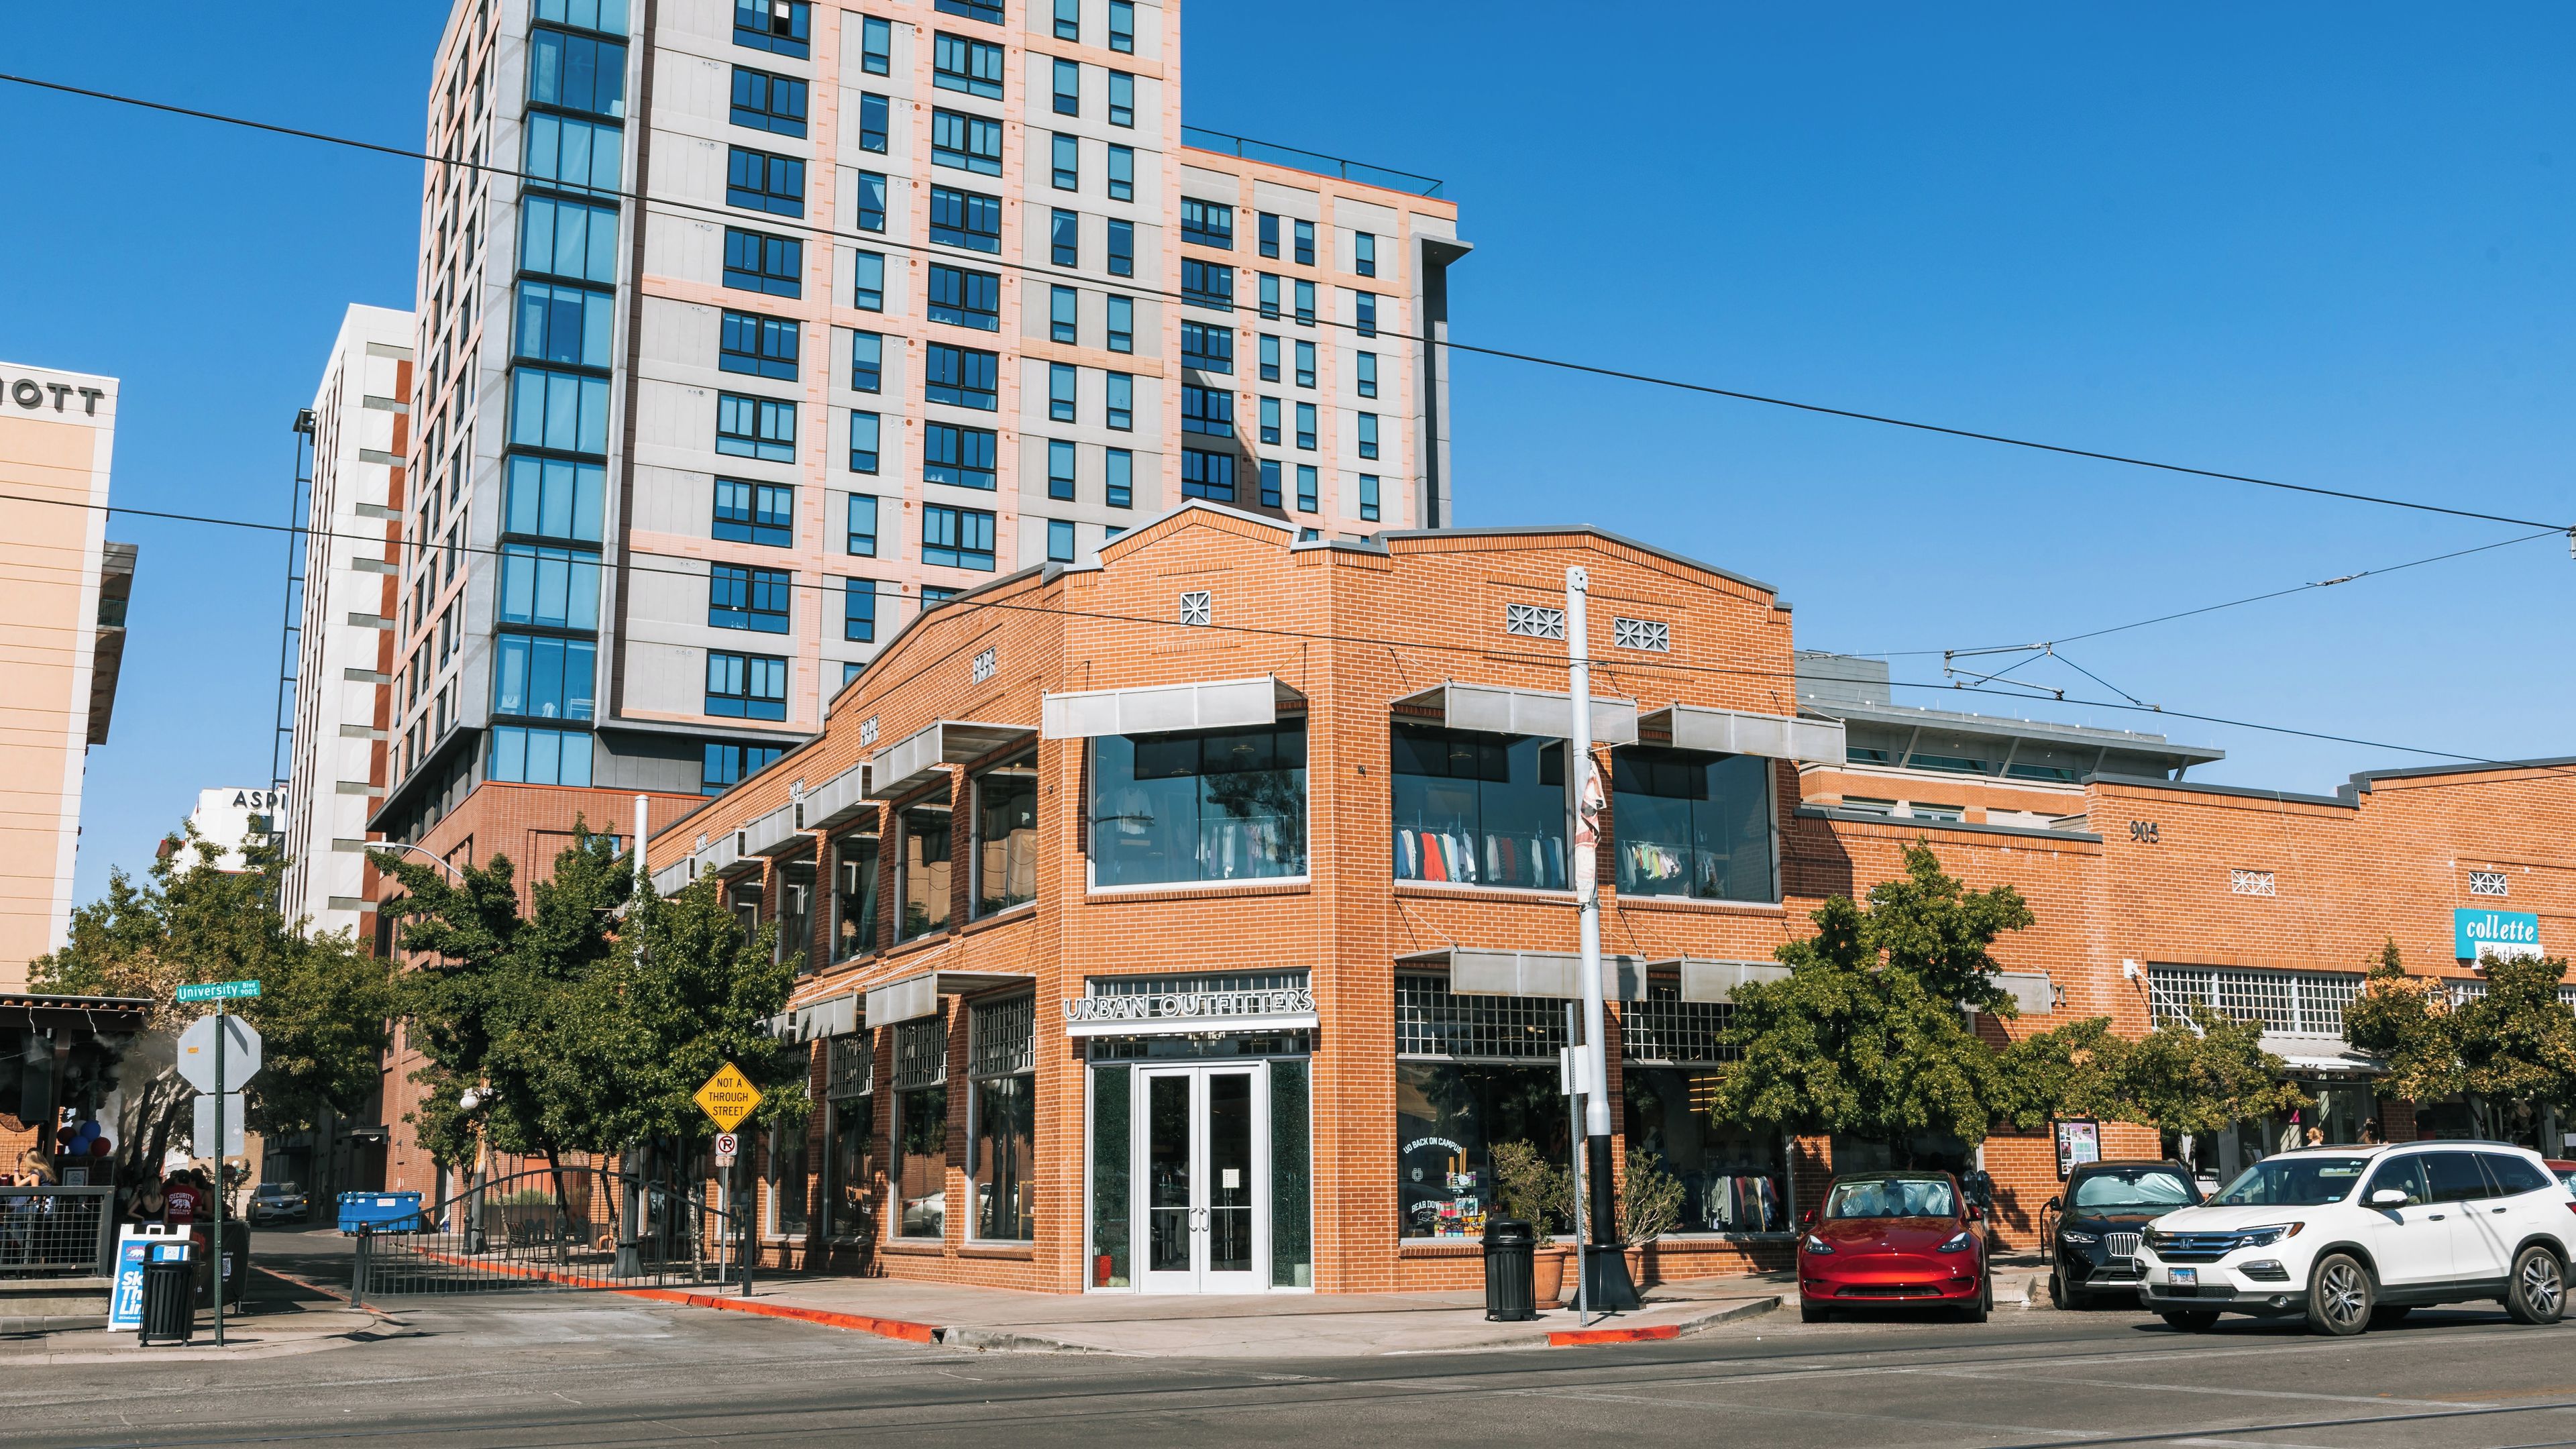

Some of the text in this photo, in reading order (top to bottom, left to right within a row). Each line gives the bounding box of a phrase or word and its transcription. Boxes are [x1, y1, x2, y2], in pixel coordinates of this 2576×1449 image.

[233, 790, 286, 810] ASPI
[2131, 820, 2159, 843] 905
[2467, 914, 2534, 941] collette
[179, 985, 237, 1000] University
[1063, 989, 1316, 1020] URBAN OUTFITTERS
[717, 1078, 743, 1088] NOT A
[708, 1092, 748, 1102] THROUGH
[712, 1106, 744, 1116] STREET
[1403, 1136, 1463, 1154] UO BACK ON CAMPUS
[169, 1192, 195, 1203] SECURITY
[1411, 1200, 1444, 1214] BEAR DOWN
[121, 1271, 143, 1286] Sk
[121, 1285, 143, 1301] Th
